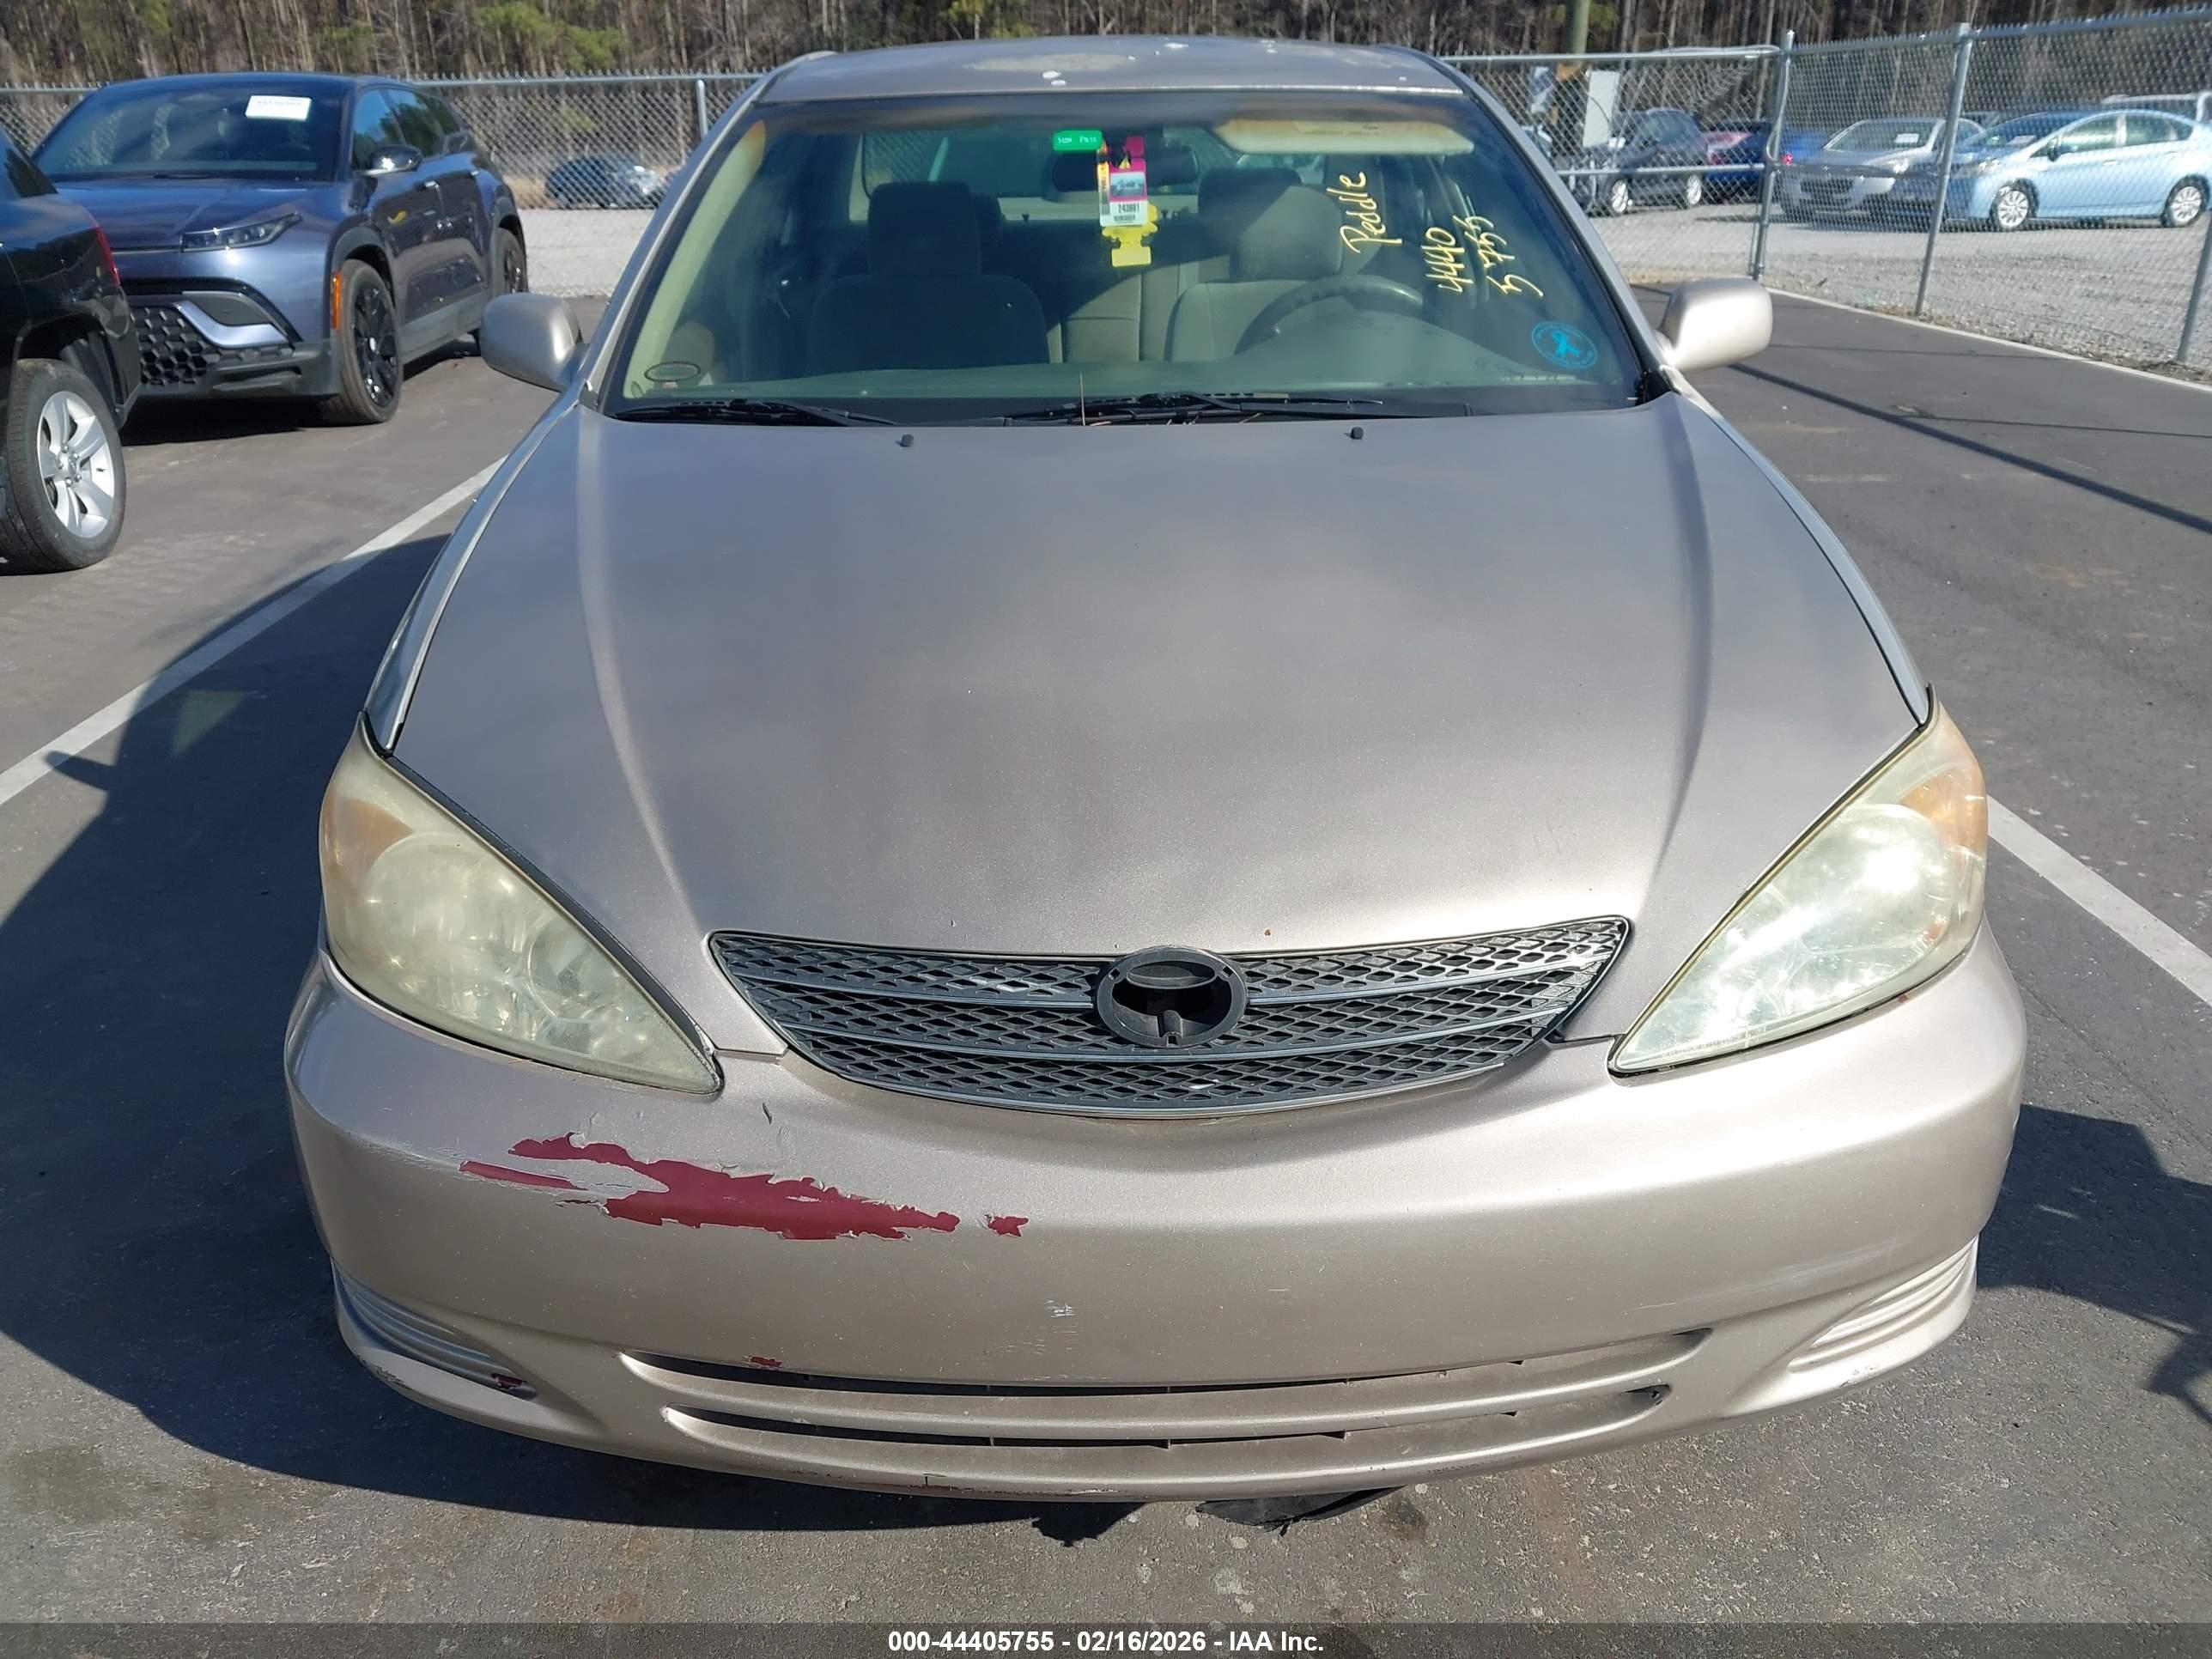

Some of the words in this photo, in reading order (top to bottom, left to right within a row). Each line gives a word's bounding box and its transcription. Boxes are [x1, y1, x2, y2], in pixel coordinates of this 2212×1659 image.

[1327, 171, 1403, 253] Peddle
[1420, 227, 1474, 293] 4440
[1452, 215, 1544, 298] 5755
